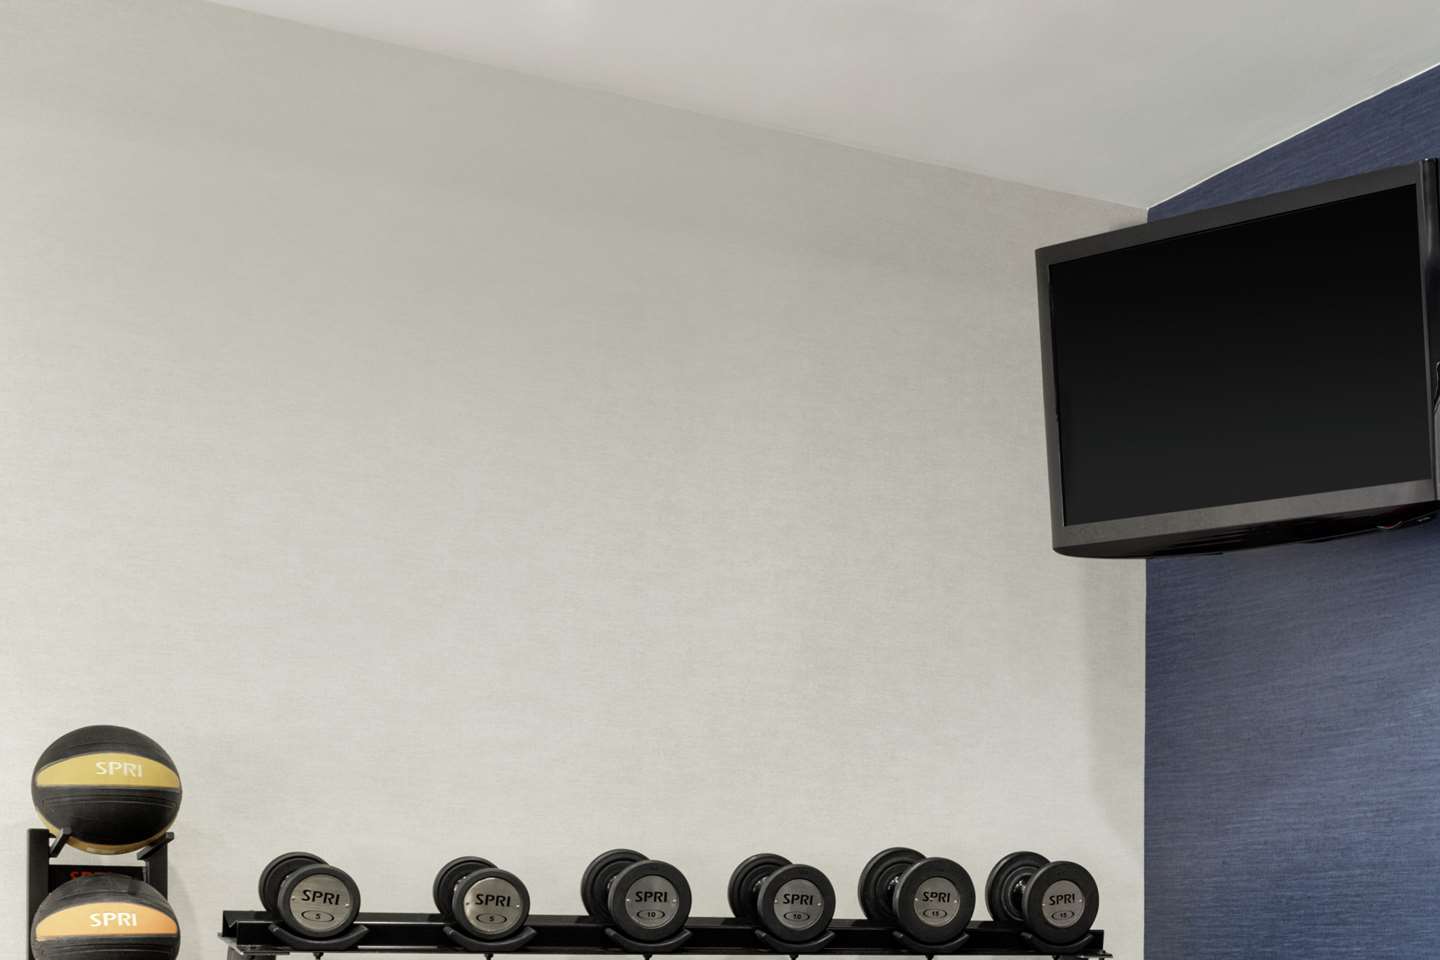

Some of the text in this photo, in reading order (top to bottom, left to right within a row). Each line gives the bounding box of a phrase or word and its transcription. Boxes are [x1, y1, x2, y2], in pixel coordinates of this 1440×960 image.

[95, 761, 143, 778] SPRI
[301, 889, 340, 906] SPRI
[475, 893, 511, 907] SPRI
[635, 890, 668, 903] SPRI
[783, 893, 814, 906] SPRI
[922, 891, 950, 903] SPRI
[1049, 893, 1075, 906] SPRI
[89, 912, 137, 927] SPRI
